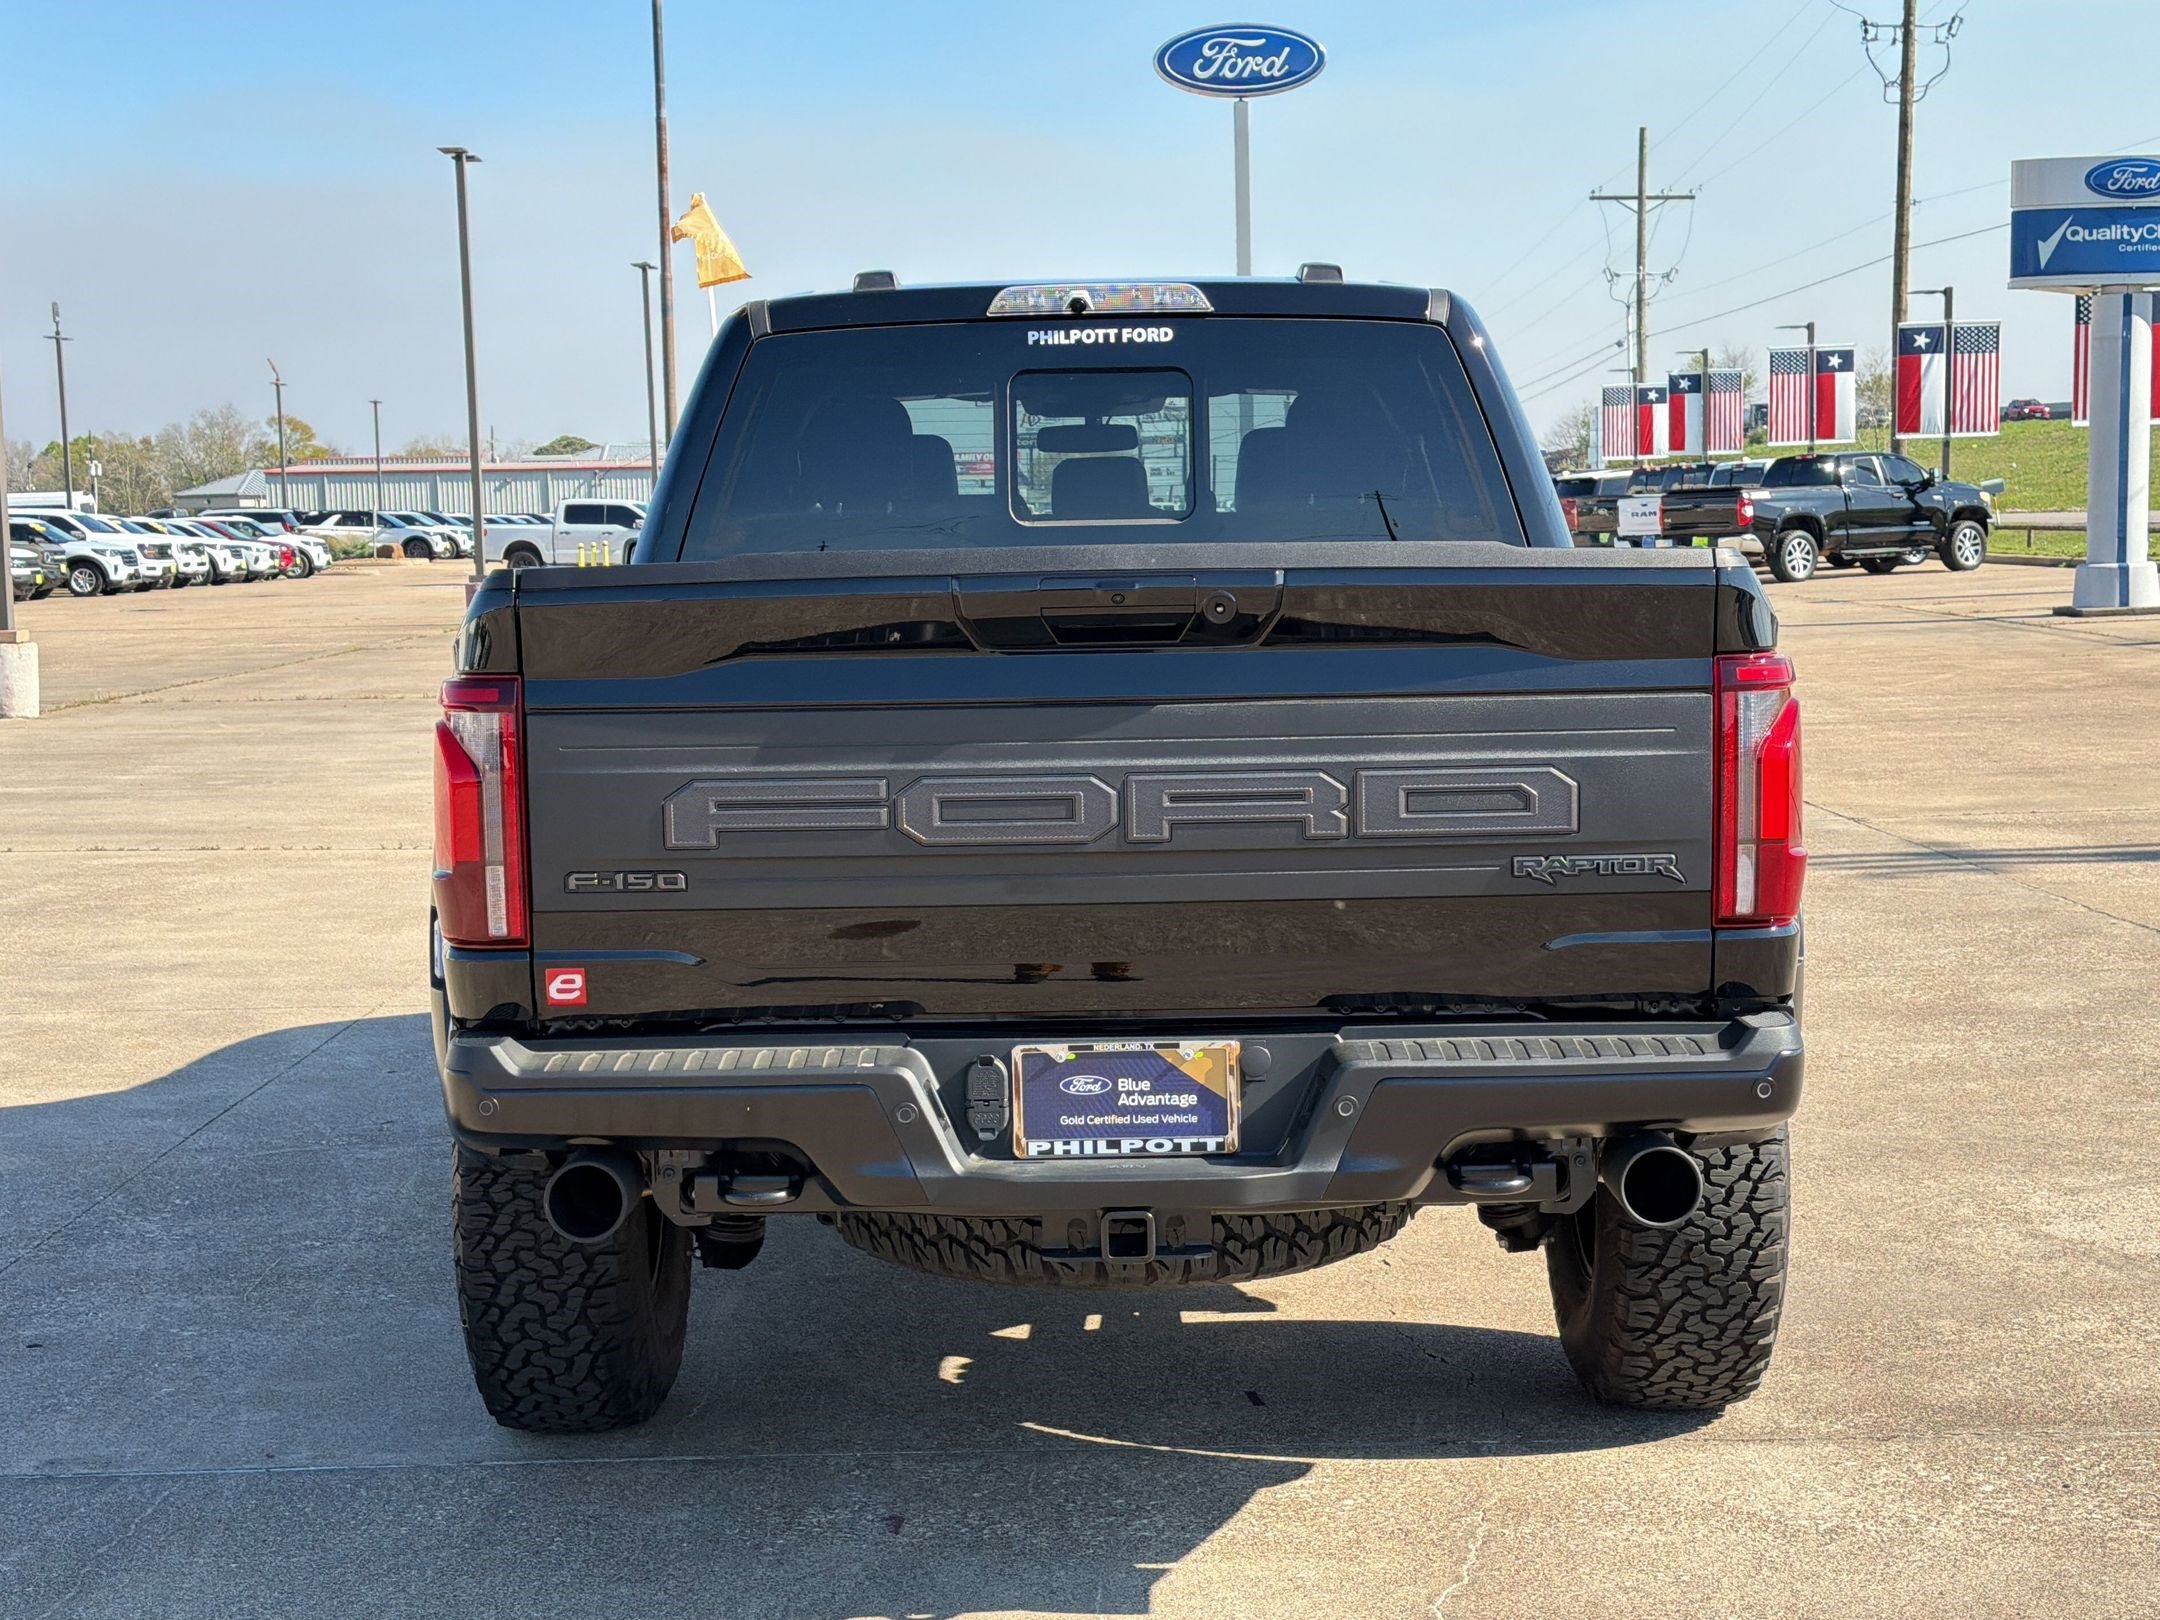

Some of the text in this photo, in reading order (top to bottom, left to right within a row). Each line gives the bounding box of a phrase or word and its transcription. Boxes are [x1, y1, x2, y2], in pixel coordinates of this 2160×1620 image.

[1192, 37, 1291, 80] Ford
[2107, 166, 2160, 191] Ford
[2118, 244, 2160, 252] Certifie
[1027, 327, 1174, 345] PHILPOTT FORD
[955, 452, 982, 462] AMILY
[663, 764, 1580, 852] FORD
[567, 861, 686, 891] F-150
[1512, 853, 1688, 886] RAPTOR
[1143, 1042, 1155, 1051] TX
[1069, 1078, 1151, 1092] Ford Blue
[1117, 1093, 1198, 1107] Advantage
[1060, 1114, 1198, 1125] Gold Certified Used Vehicle
[1028, 1137, 1225, 1156] PHILPOTT
